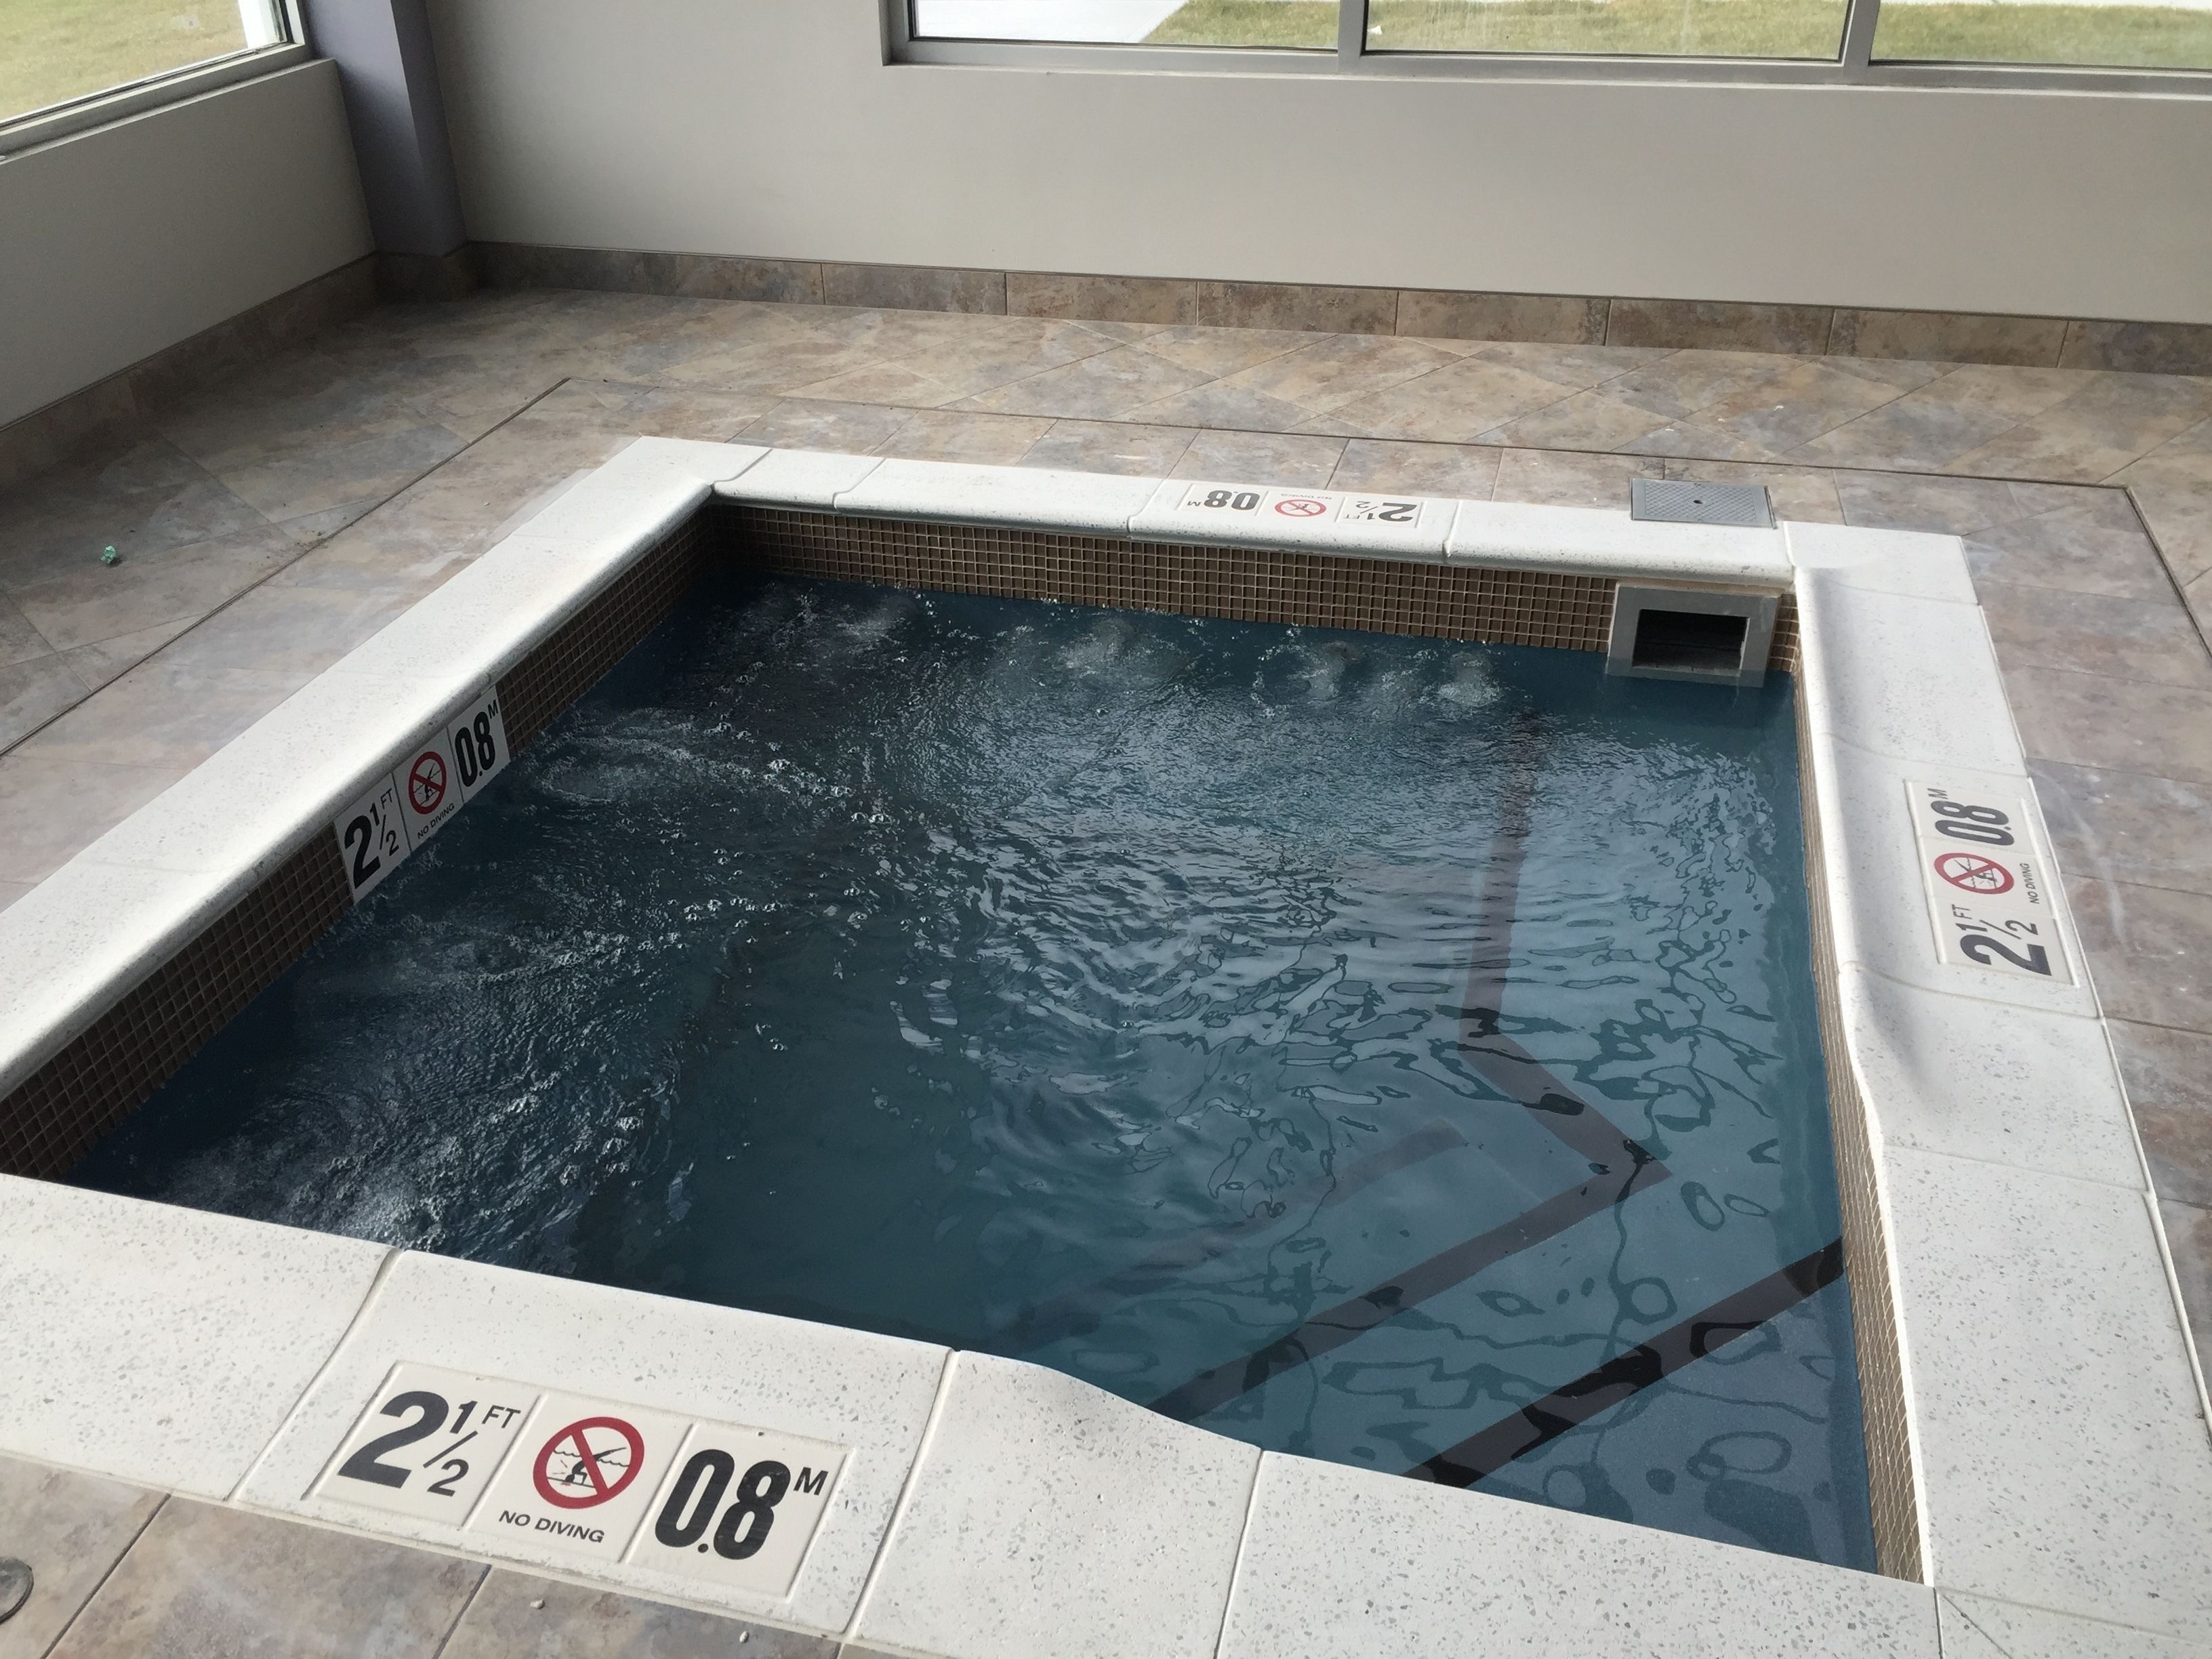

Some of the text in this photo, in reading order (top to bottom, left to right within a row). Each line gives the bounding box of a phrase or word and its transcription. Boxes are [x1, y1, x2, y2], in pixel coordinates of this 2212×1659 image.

[487, 699, 499, 719] M
[380, 787, 393, 809] FT
[1927, 788, 1948, 799] M
[417, 803, 455, 839] NO DIVING
[2019, 863, 2040, 904] NO DIVING
[1952, 904, 1972, 919] FT
[482, 1405, 520, 1429] FT
[794, 1467, 830, 1496] M
[498, 1510, 605, 1544] NO DIVING
